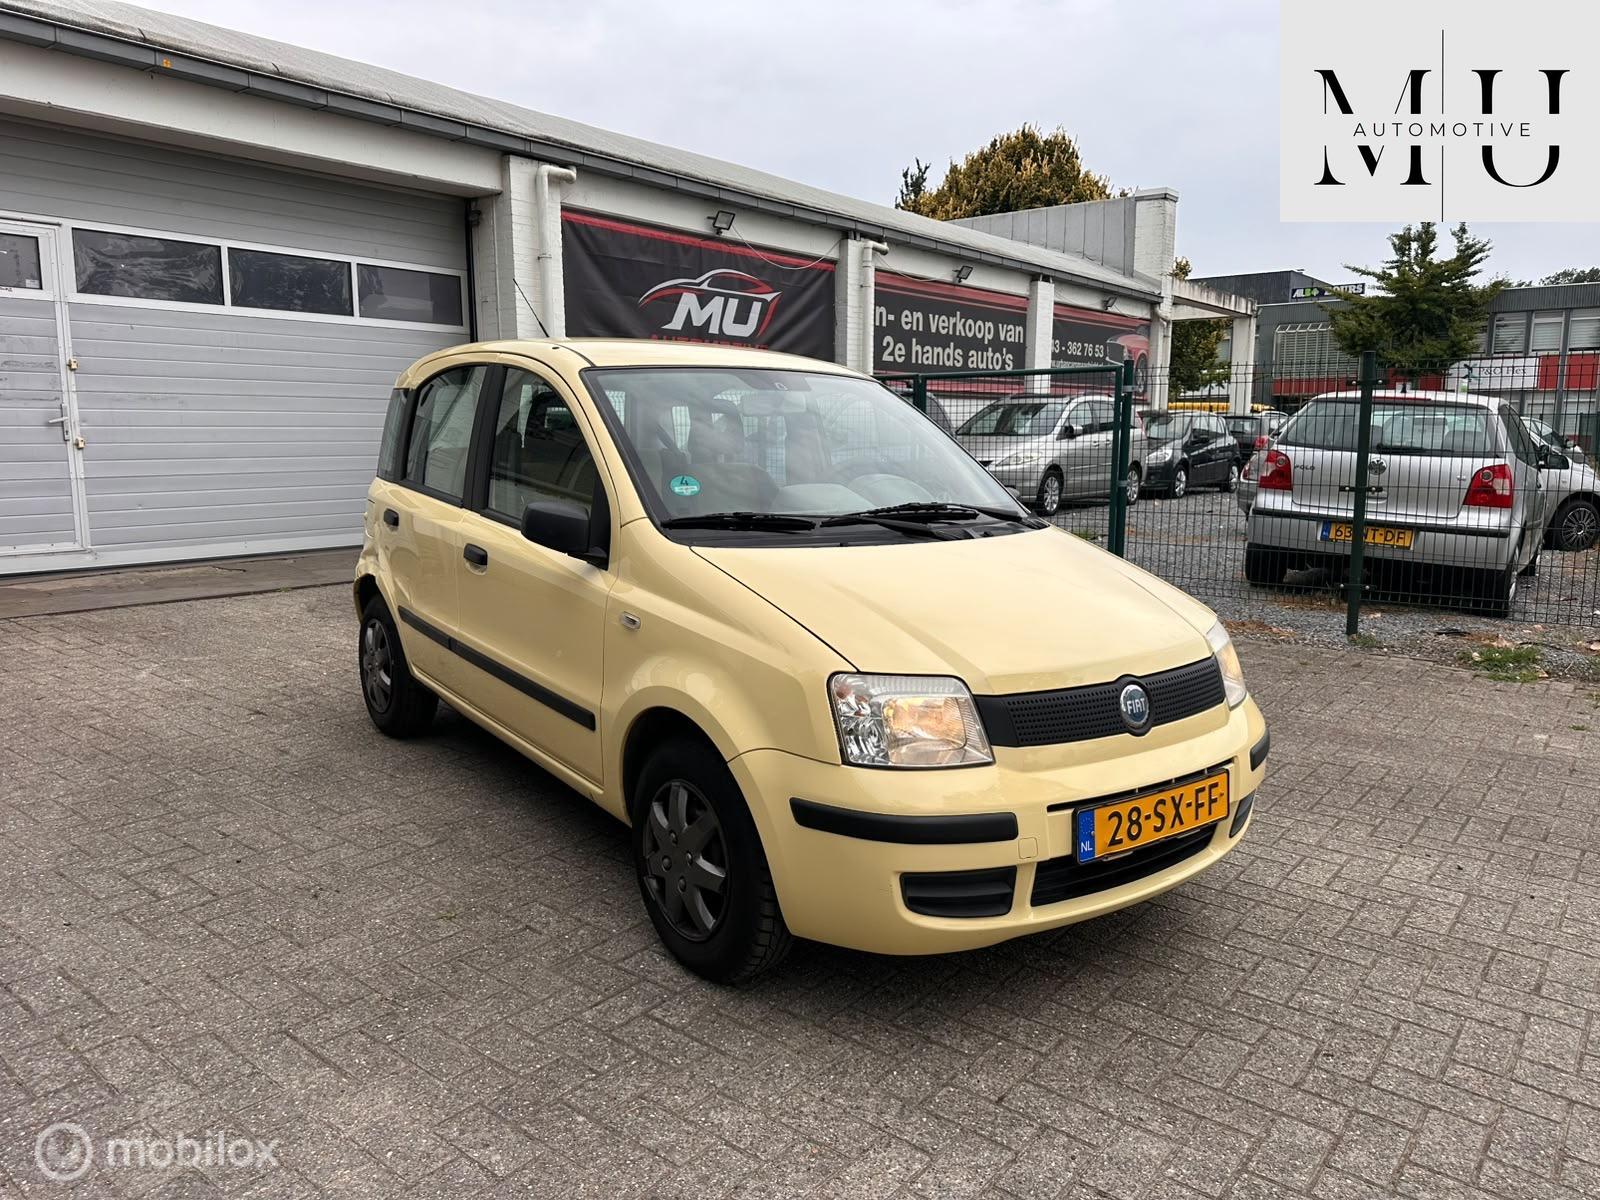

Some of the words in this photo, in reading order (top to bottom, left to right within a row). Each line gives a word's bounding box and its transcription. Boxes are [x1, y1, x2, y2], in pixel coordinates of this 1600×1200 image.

[660, 291, 762, 338] MU
[901, 309, 924, 332] en
[928, 311, 995, 344] verkoop
[998, 323, 1024, 344] van
[882, 335, 906, 363] 2e
[911, 338, 963, 368] hands
[968, 347, 1014, 371] auto's
[1066, 341, 1082, 356] 362
[1083, 343, 1093, 357] 76
[1094, 344, 1104, 358] 53
[1126, 698, 1146, 715] FIAT
[1107, 781, 1219, 847] 28-SX-FF
[1080, 841, 1093, 853] NL
